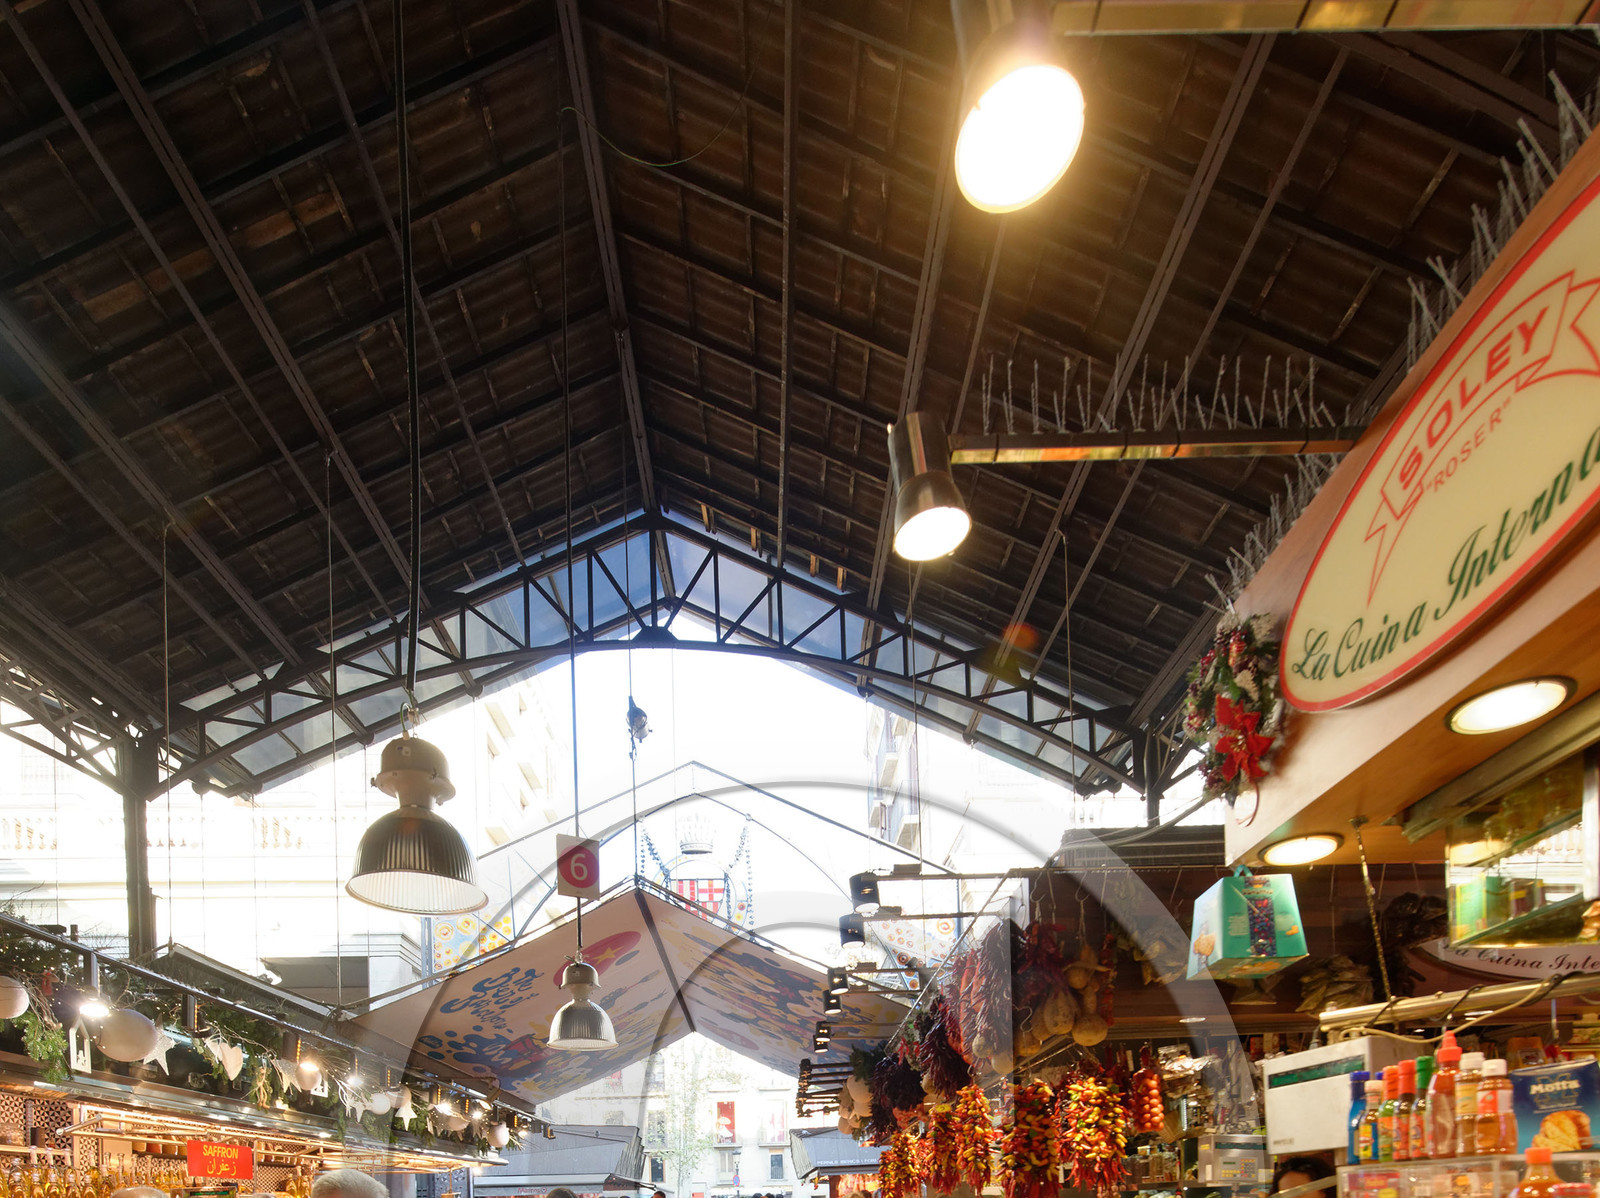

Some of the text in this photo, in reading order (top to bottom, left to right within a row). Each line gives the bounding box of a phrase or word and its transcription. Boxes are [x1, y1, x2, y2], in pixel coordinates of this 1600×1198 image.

[1399, 305, 1550, 491] SOLEY
[1292, 627, 1330, 681] La
[1333, 602, 1428, 678] Cuina
[570, 853, 588, 881] 6
[1529, 1079, 1582, 1095] Motta
[202, 1144, 239, 1159] SAFFRON
[206, 1158, 237, 1176] زعفران
